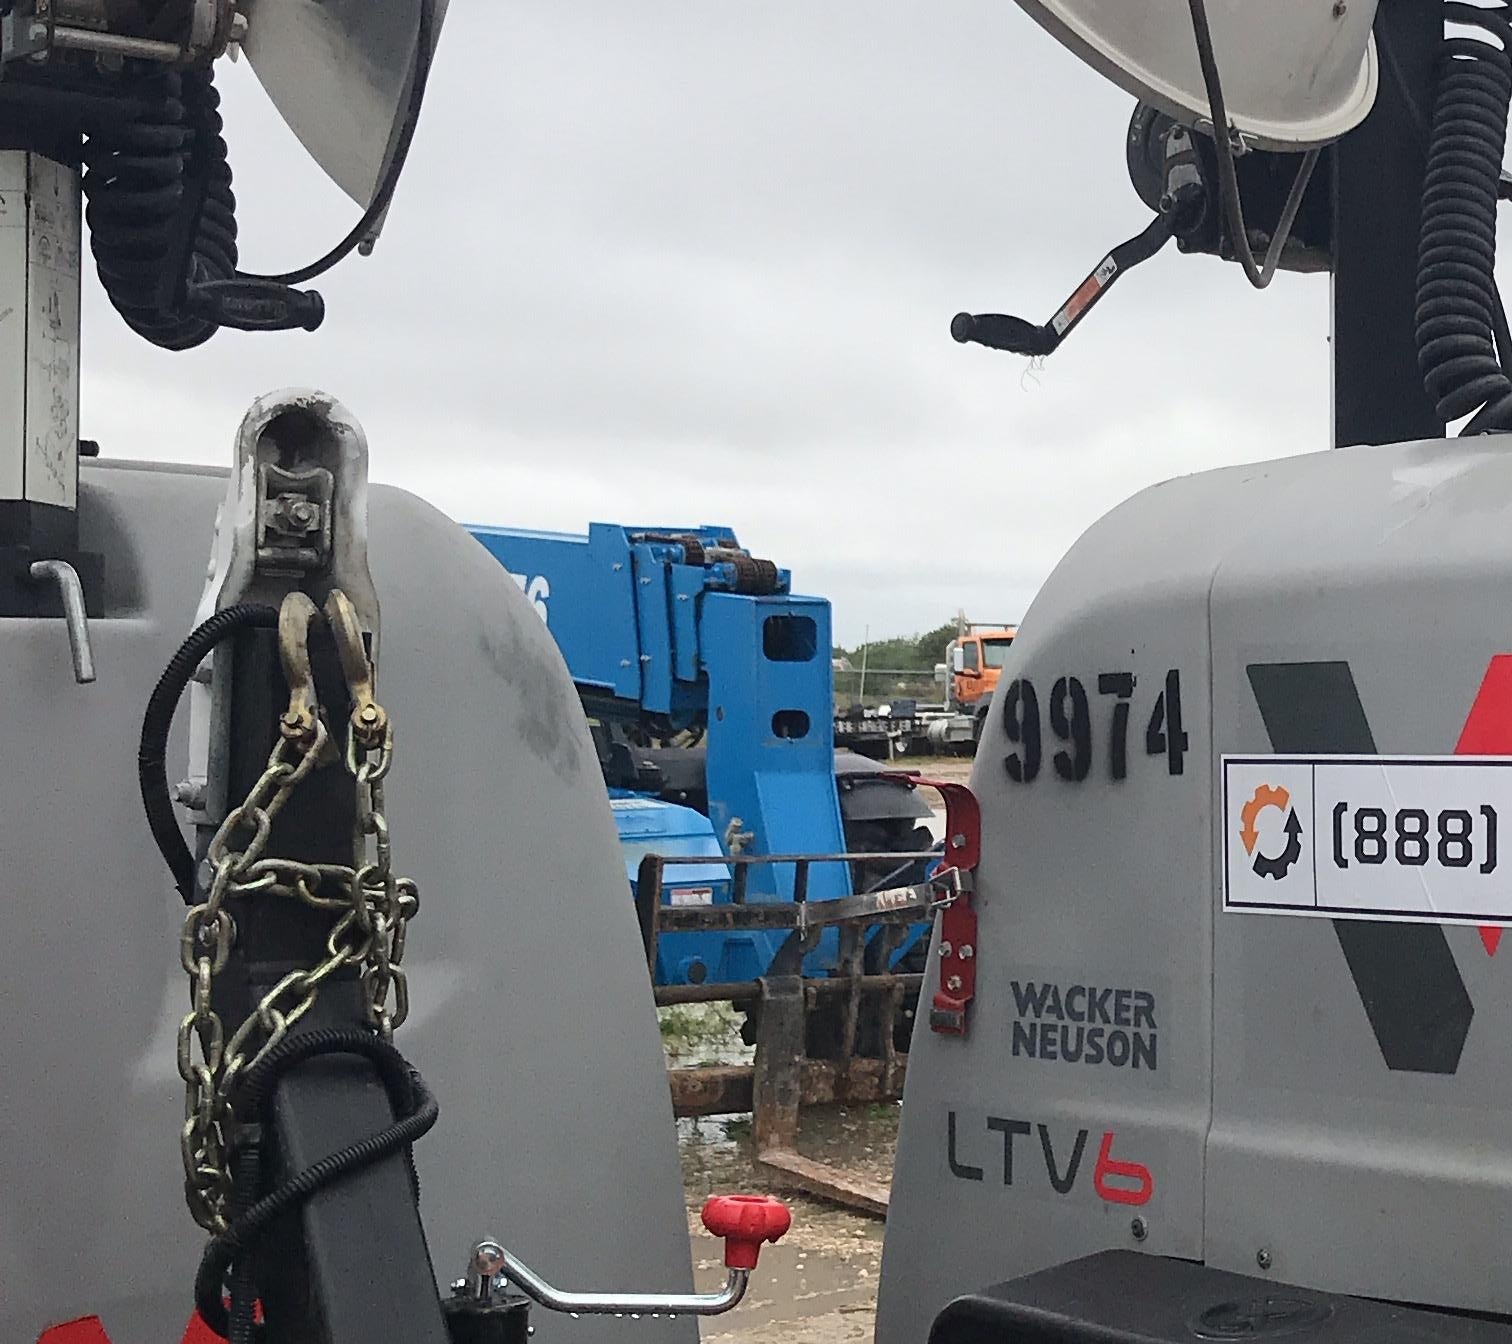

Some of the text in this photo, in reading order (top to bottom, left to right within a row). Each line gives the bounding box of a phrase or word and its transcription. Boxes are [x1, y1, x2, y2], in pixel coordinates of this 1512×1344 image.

[1003, 669, 1188, 783] 9974
[1332, 802, 1497, 874] (888)
[1011, 981, 1157, 1030] WACKER
[1011, 1021, 1157, 1071] NEUSON
[948, 1111, 1153, 1207] LTV6
